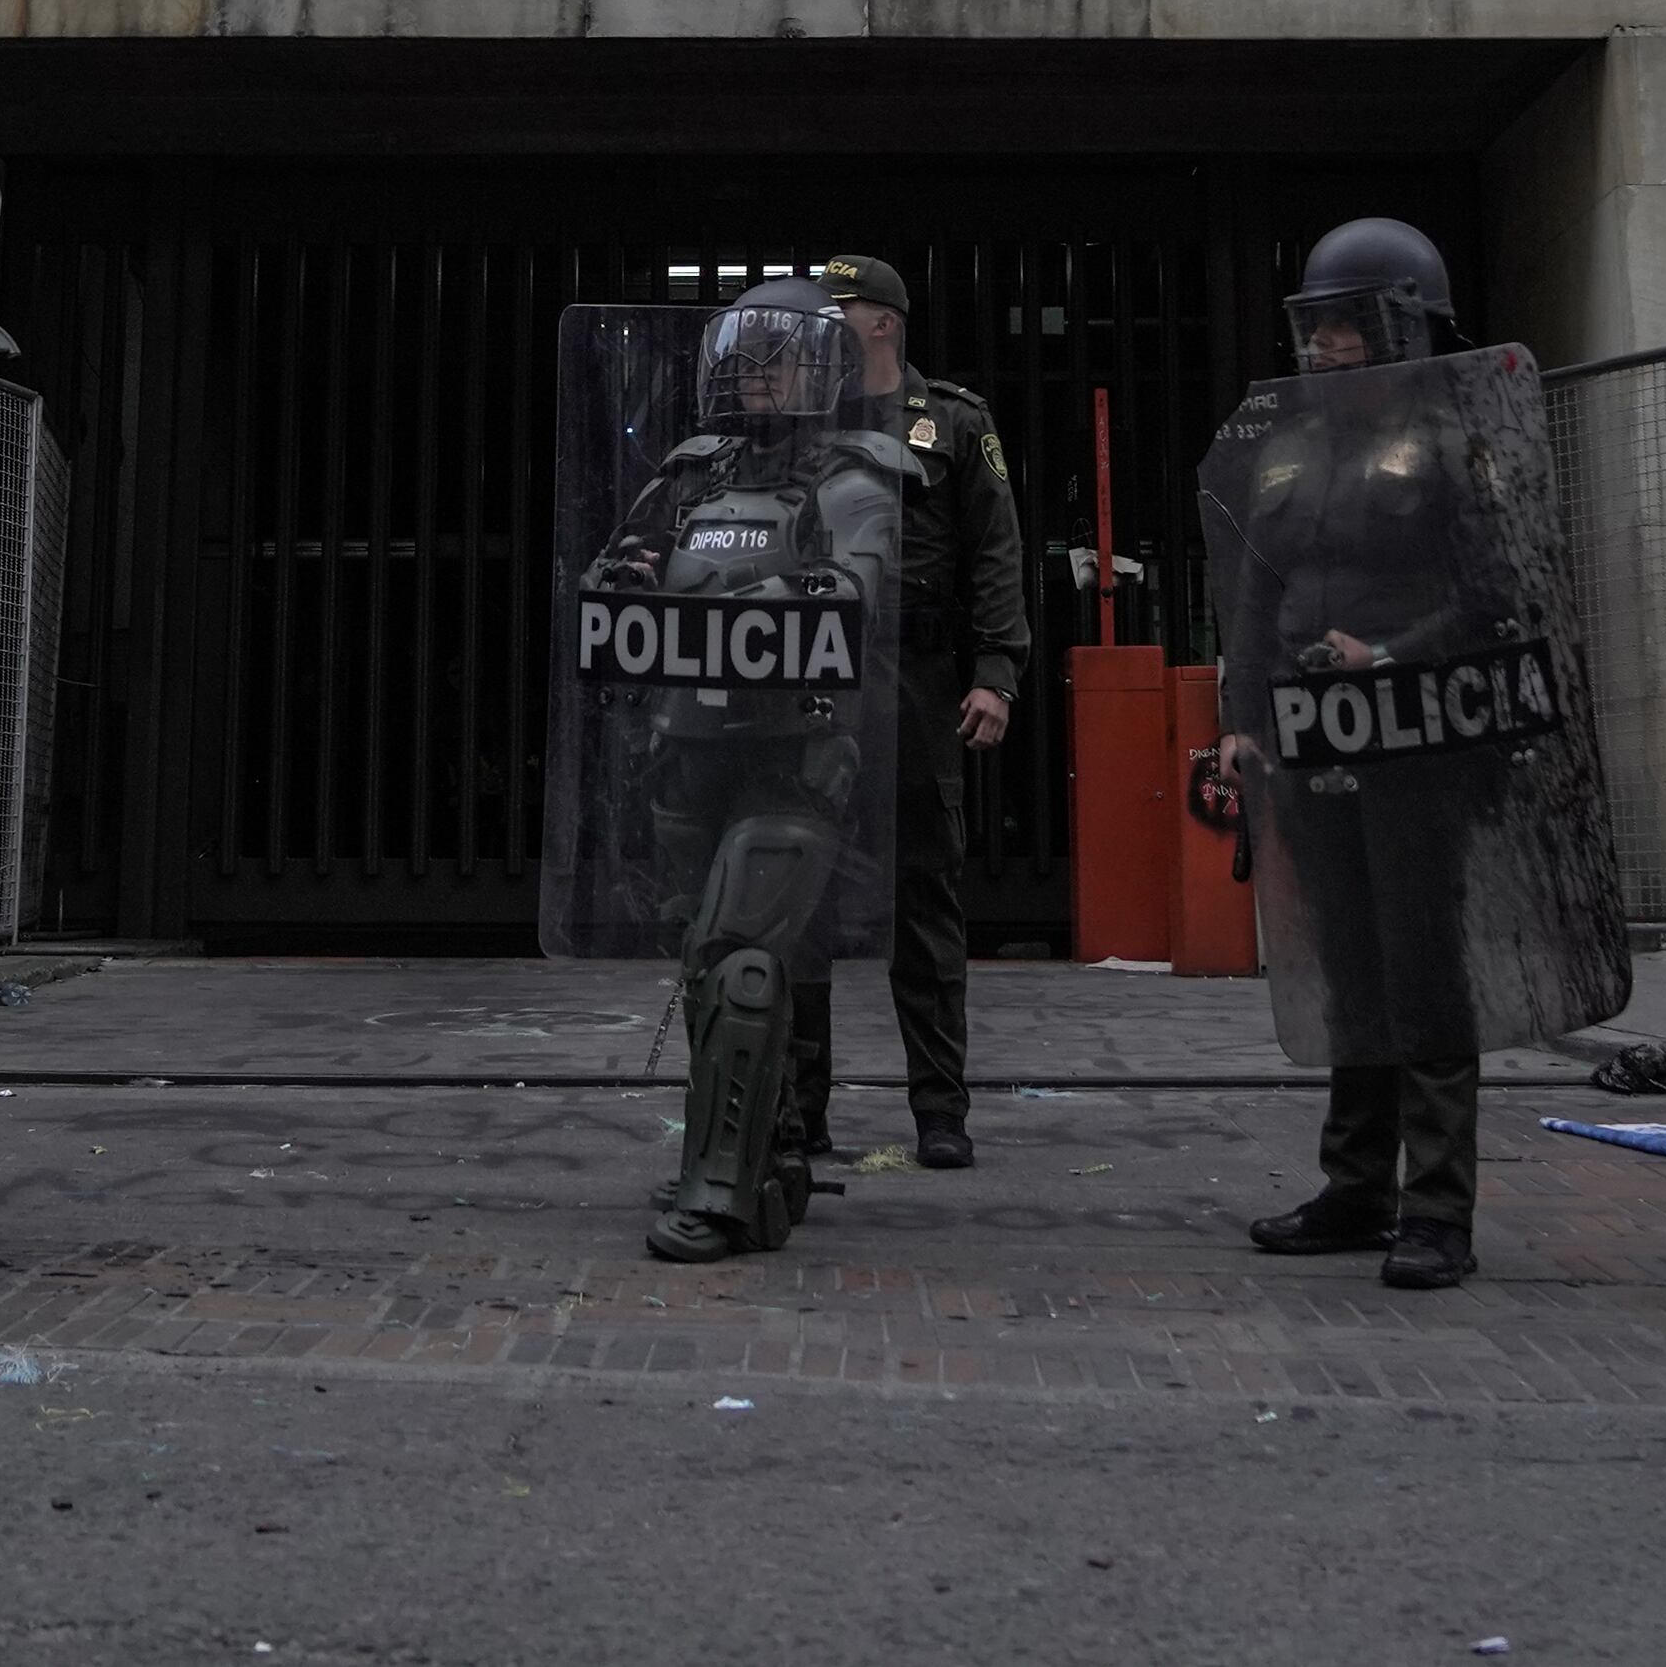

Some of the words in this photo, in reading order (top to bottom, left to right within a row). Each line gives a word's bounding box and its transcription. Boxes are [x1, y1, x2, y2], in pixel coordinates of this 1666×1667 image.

[825, 260, 859, 280] ICIA
[761, 310, 793, 331] 116
[689, 529, 735, 551] DIPRO
[739, 529, 769, 549] 116
[579, 600, 855, 681] POLICIA
[1271, 652, 1555, 760] POLICIA
